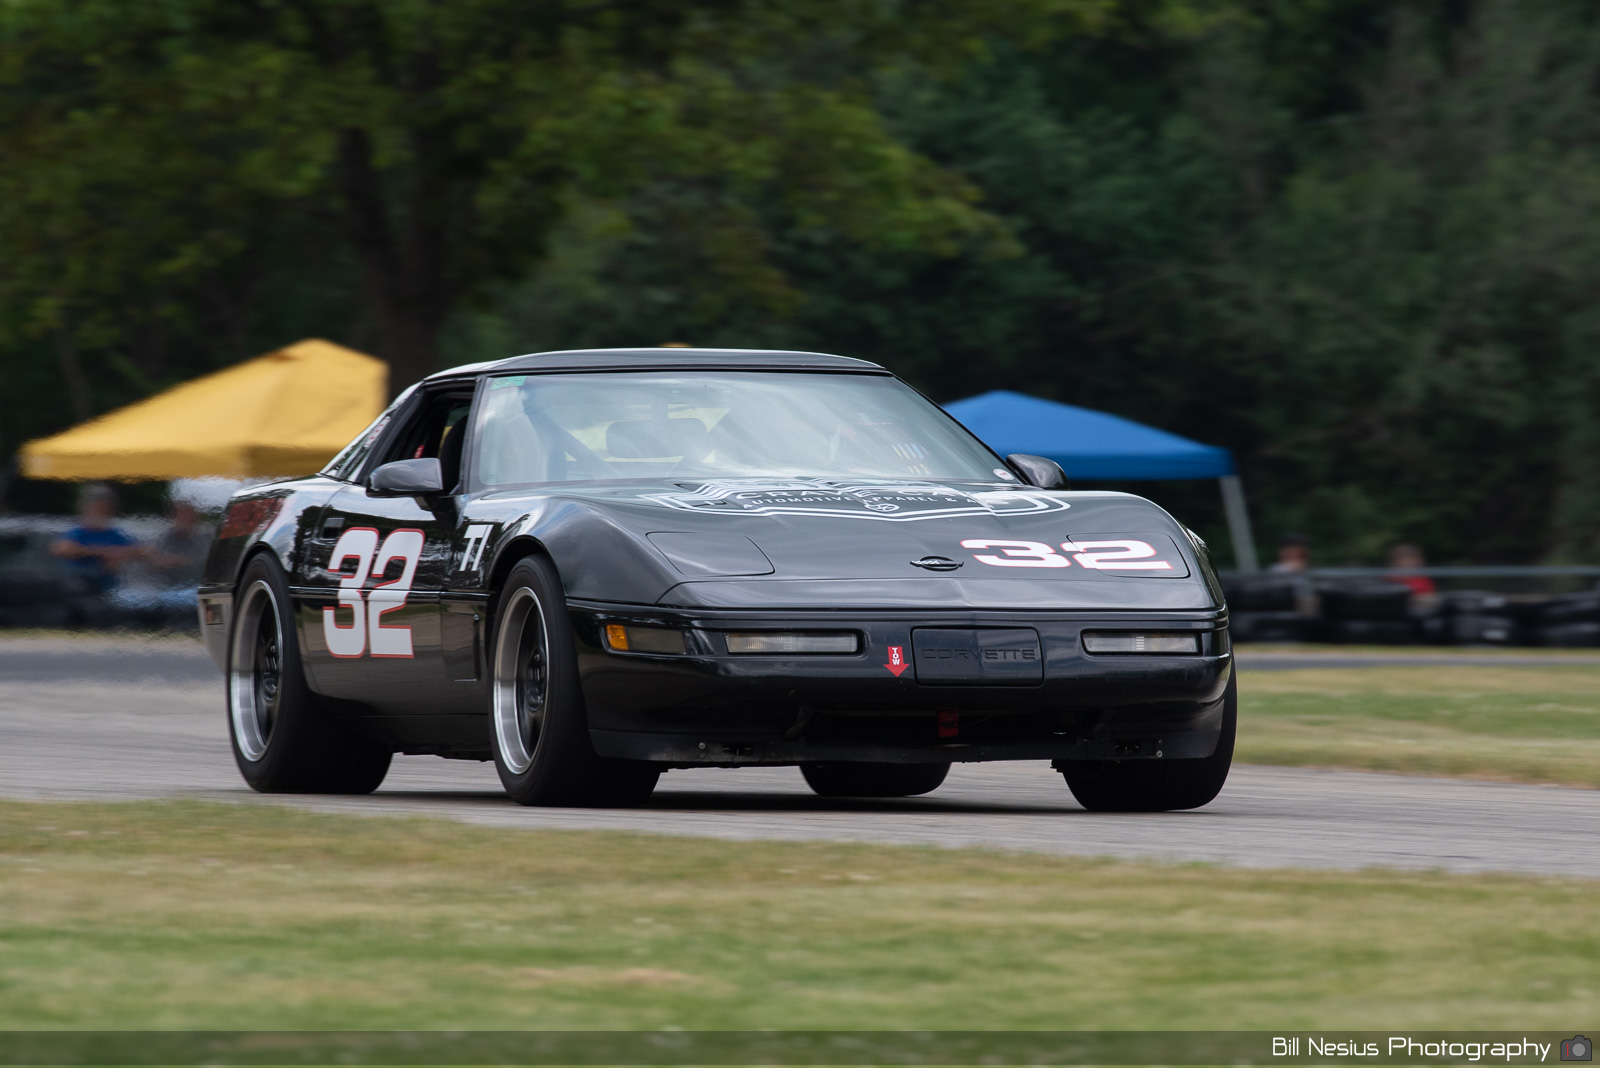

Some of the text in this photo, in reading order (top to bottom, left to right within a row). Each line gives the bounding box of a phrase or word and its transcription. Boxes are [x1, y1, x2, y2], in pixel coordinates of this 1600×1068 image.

[743, 496, 856, 509] AUTOMOTIVE
[862, 496, 938, 504] APPAREL
[960, 539, 1174, 570] 32
[322, 526, 426, 659] 32
[891, 647, 901, 665] TOW
[922, 648, 1036, 660] CORVETTE
